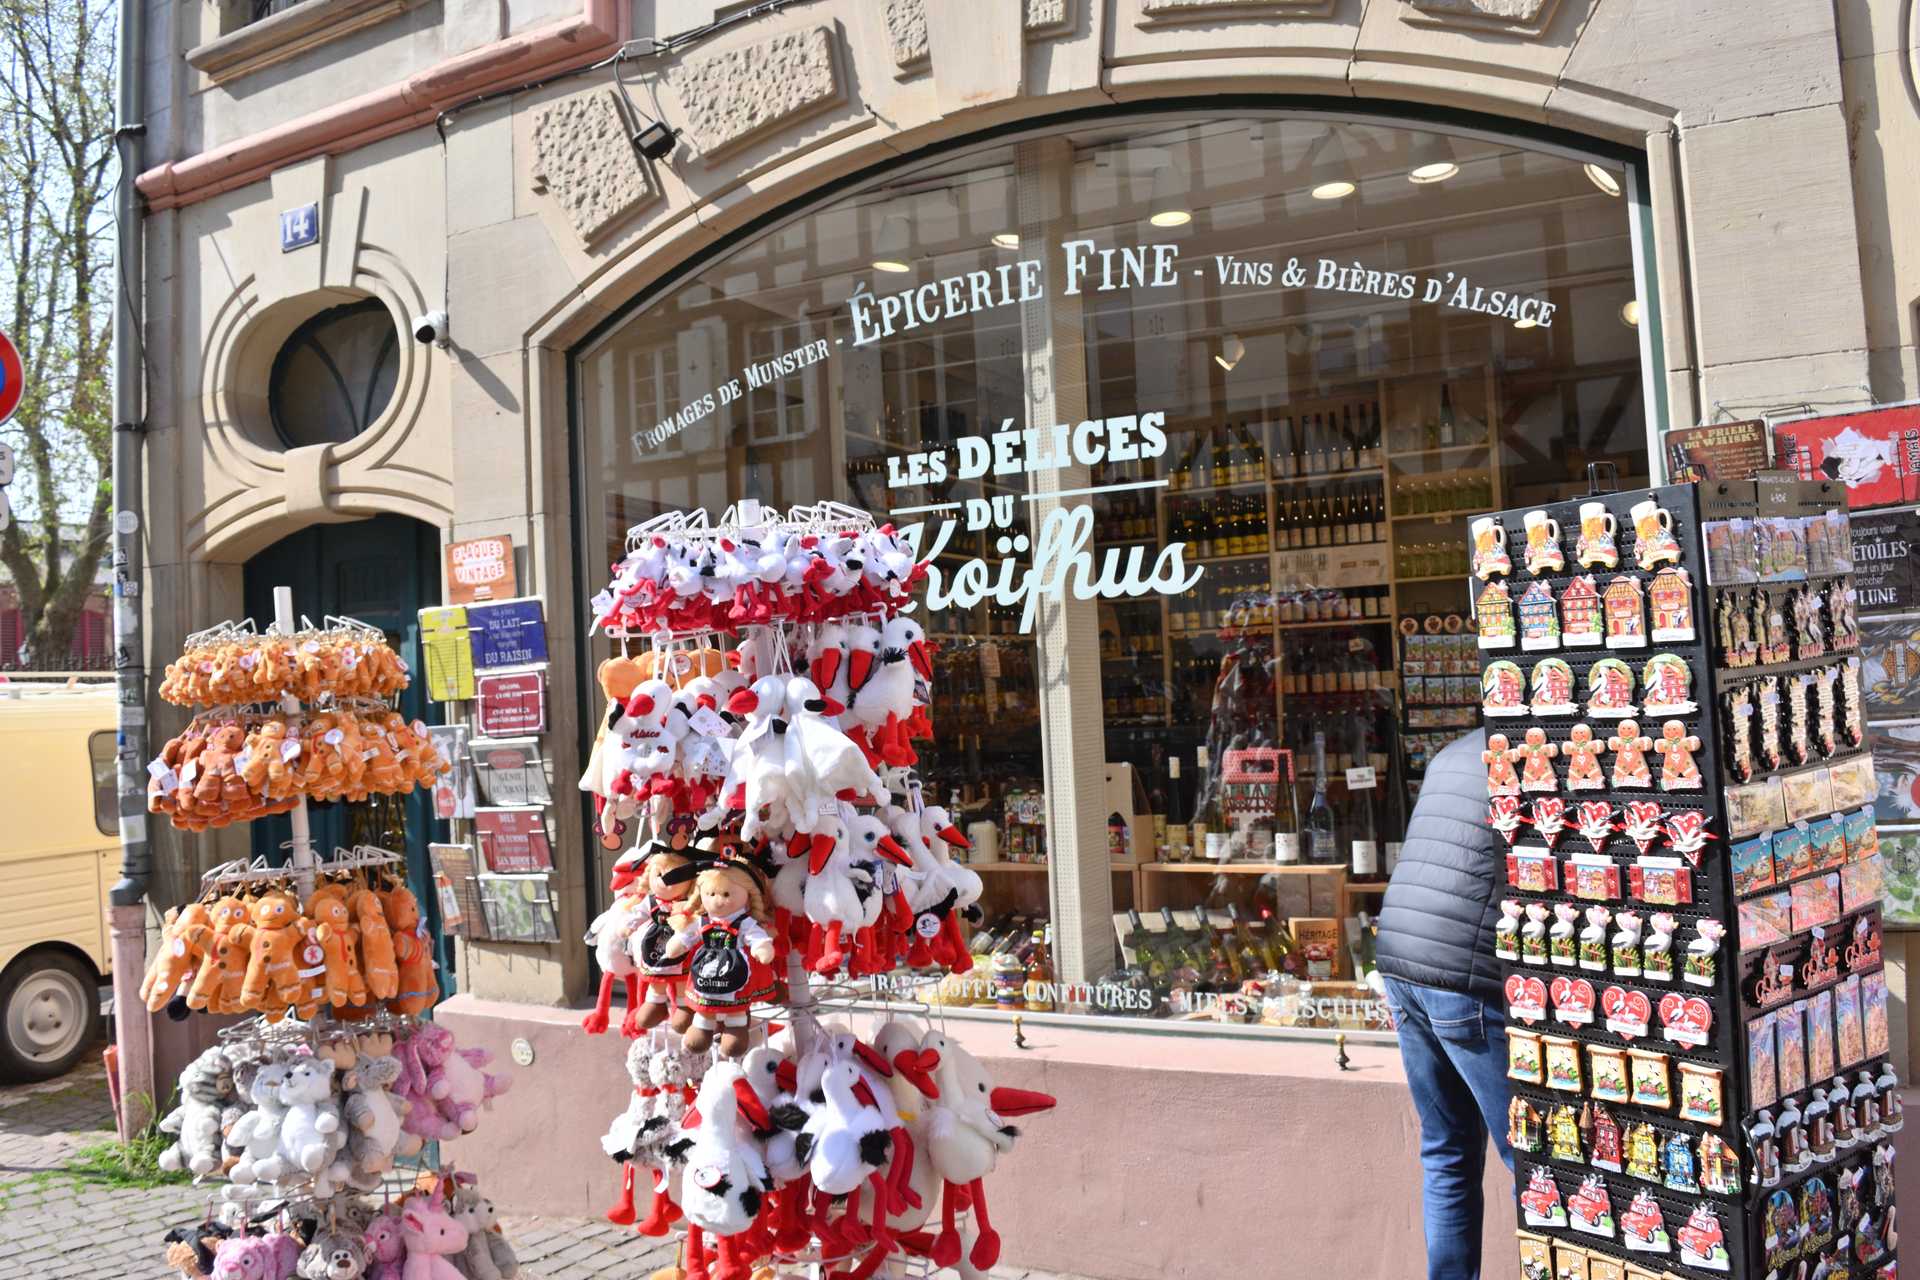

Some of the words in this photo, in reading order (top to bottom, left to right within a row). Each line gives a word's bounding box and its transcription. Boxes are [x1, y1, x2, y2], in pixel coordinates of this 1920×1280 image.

[285, 211, 309, 243] 14
[631, 393, 716, 456] FROMAGES
[718, 378, 743, 406] DE
[743, 338, 830, 392] MUNSTER
[845, 259, 1044, 347] ÉPICERIE
[1061, 239, 1180, 296] FINE
[1215, 254, 1274, 286] VINS
[1281, 257, 1306, 288] &
[1314, 258, 1416, 299] BIÈRES
[887, 451, 948, 488] LES
[958, 411, 1168, 479] DÉLICES
[966, 495, 1014, 531] DU
[453, 541, 504, 564] PLAQUES
[1851, 540, 1908, 562] ÉTOILES
[455, 560, 505, 584] VINTAGE
[897, 504, 1205, 635] Koïfhus
[1859, 587, 1899, 606] LUNE
[484, 651, 498, 665] DU
[500, 648, 532, 663] RAISIN
[696, 978, 729, 988] Colmar
[1023, 981, 1153, 1010] CONFITURES
